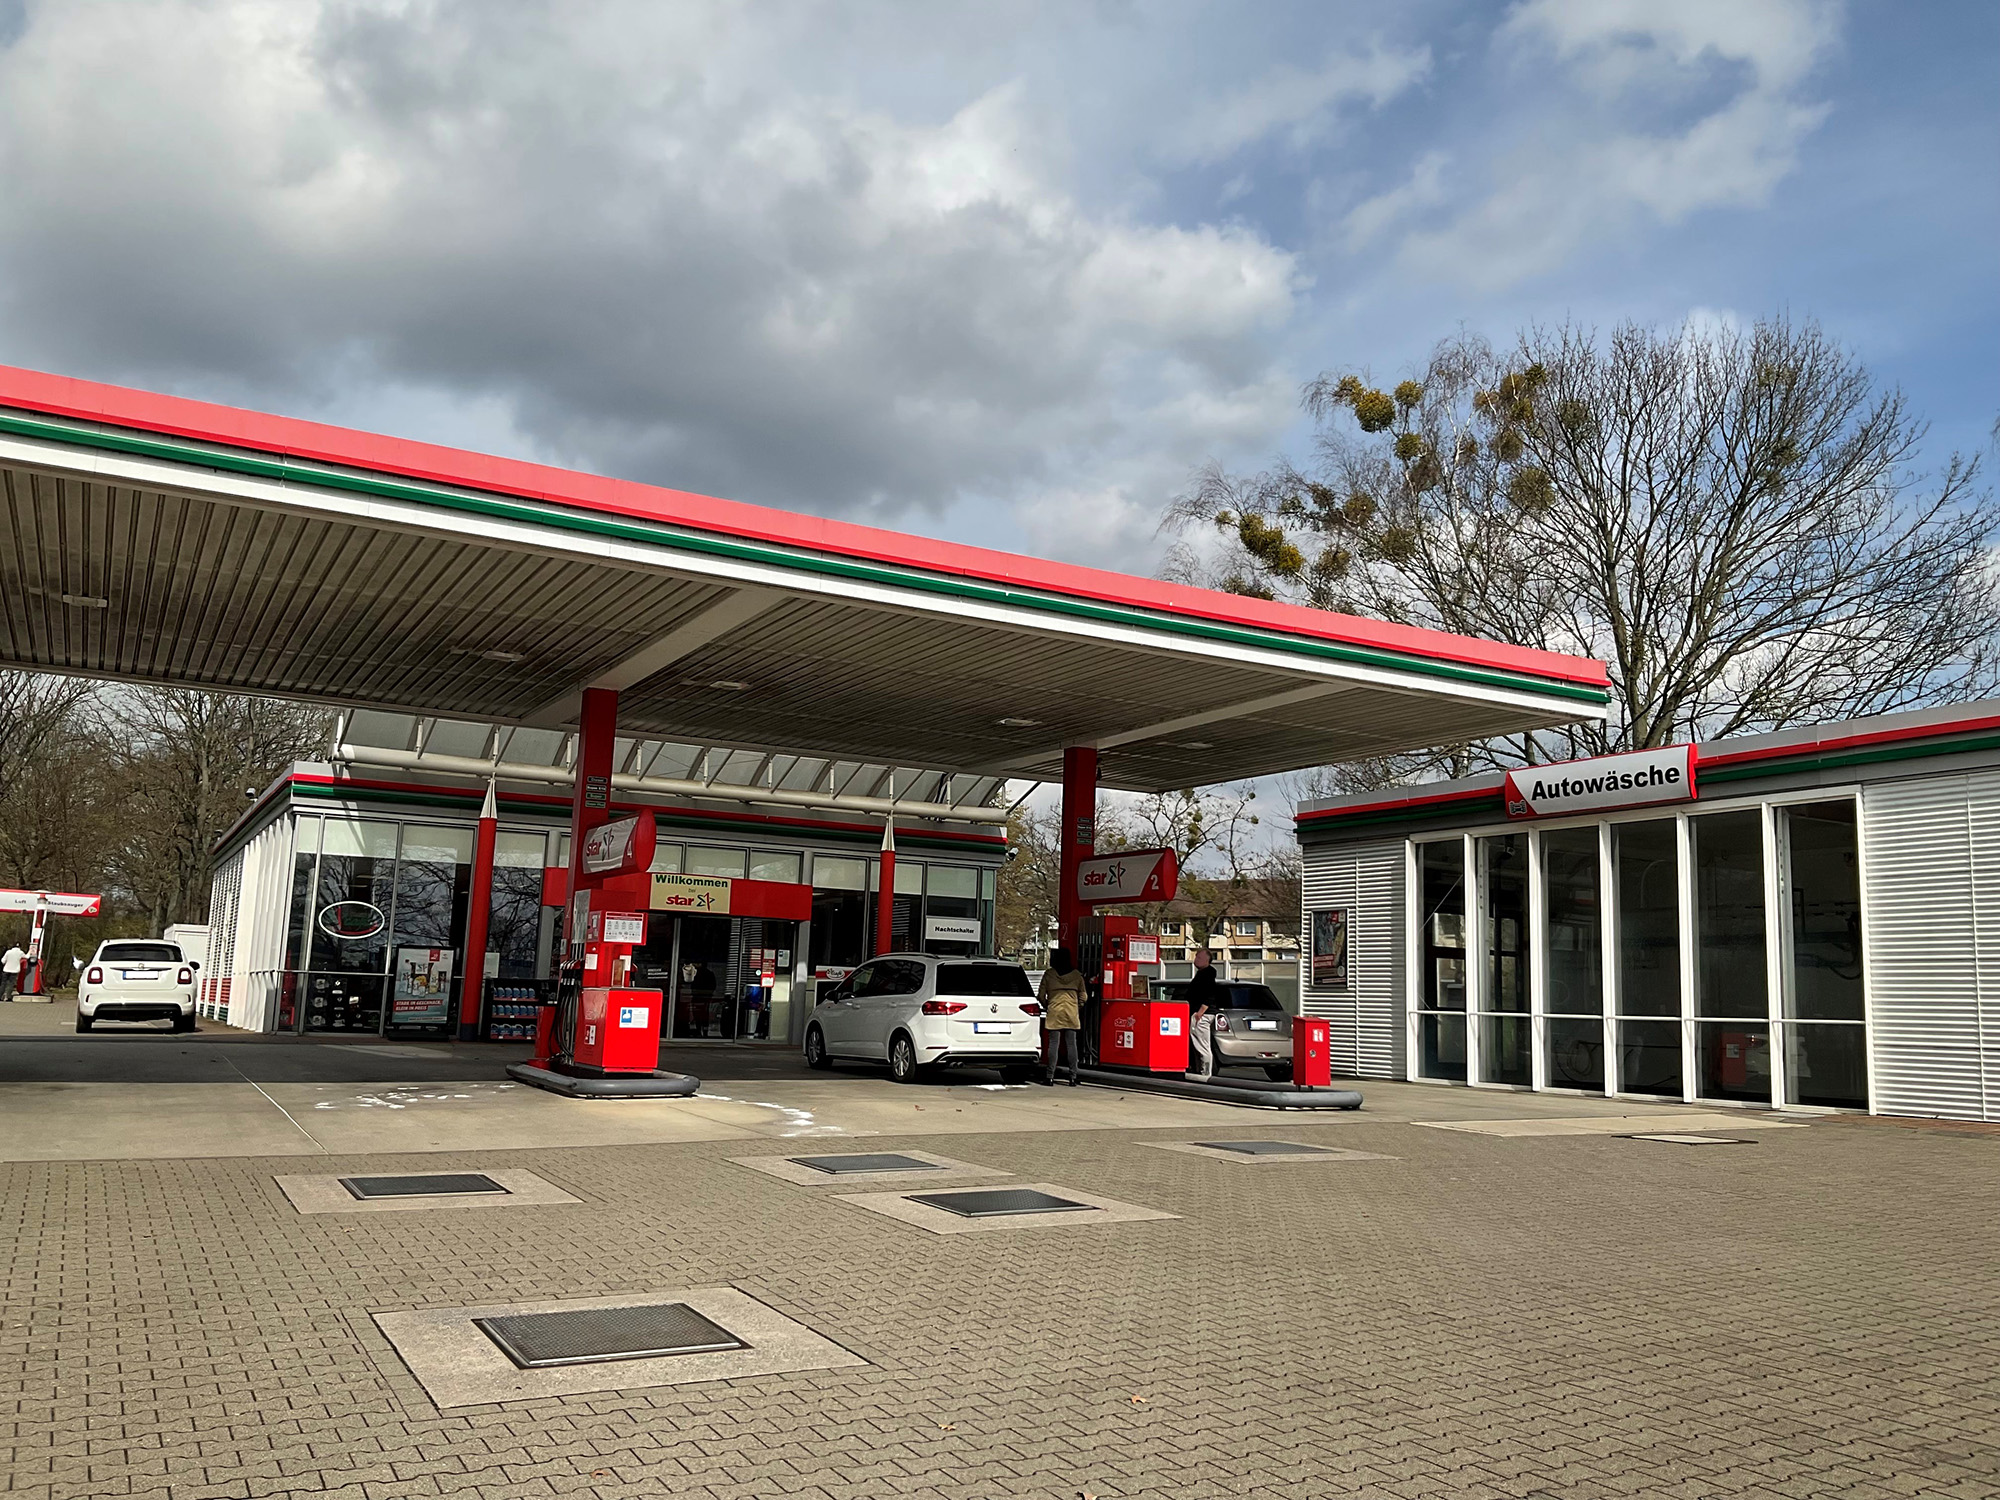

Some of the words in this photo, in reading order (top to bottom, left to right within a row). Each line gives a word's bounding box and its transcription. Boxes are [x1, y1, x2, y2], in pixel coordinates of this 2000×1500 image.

[1531, 764, 1681, 801] Autowäsche
[586, 838, 603, 857] star
[626, 840, 633, 859] 4
[655, 874, 728, 888] Willkommen
[1083, 870, 1107, 886] star
[1150, 874, 1159, 890] 2
[665, 894, 695, 906] star
[934, 926, 975, 934] Nachtschalter
